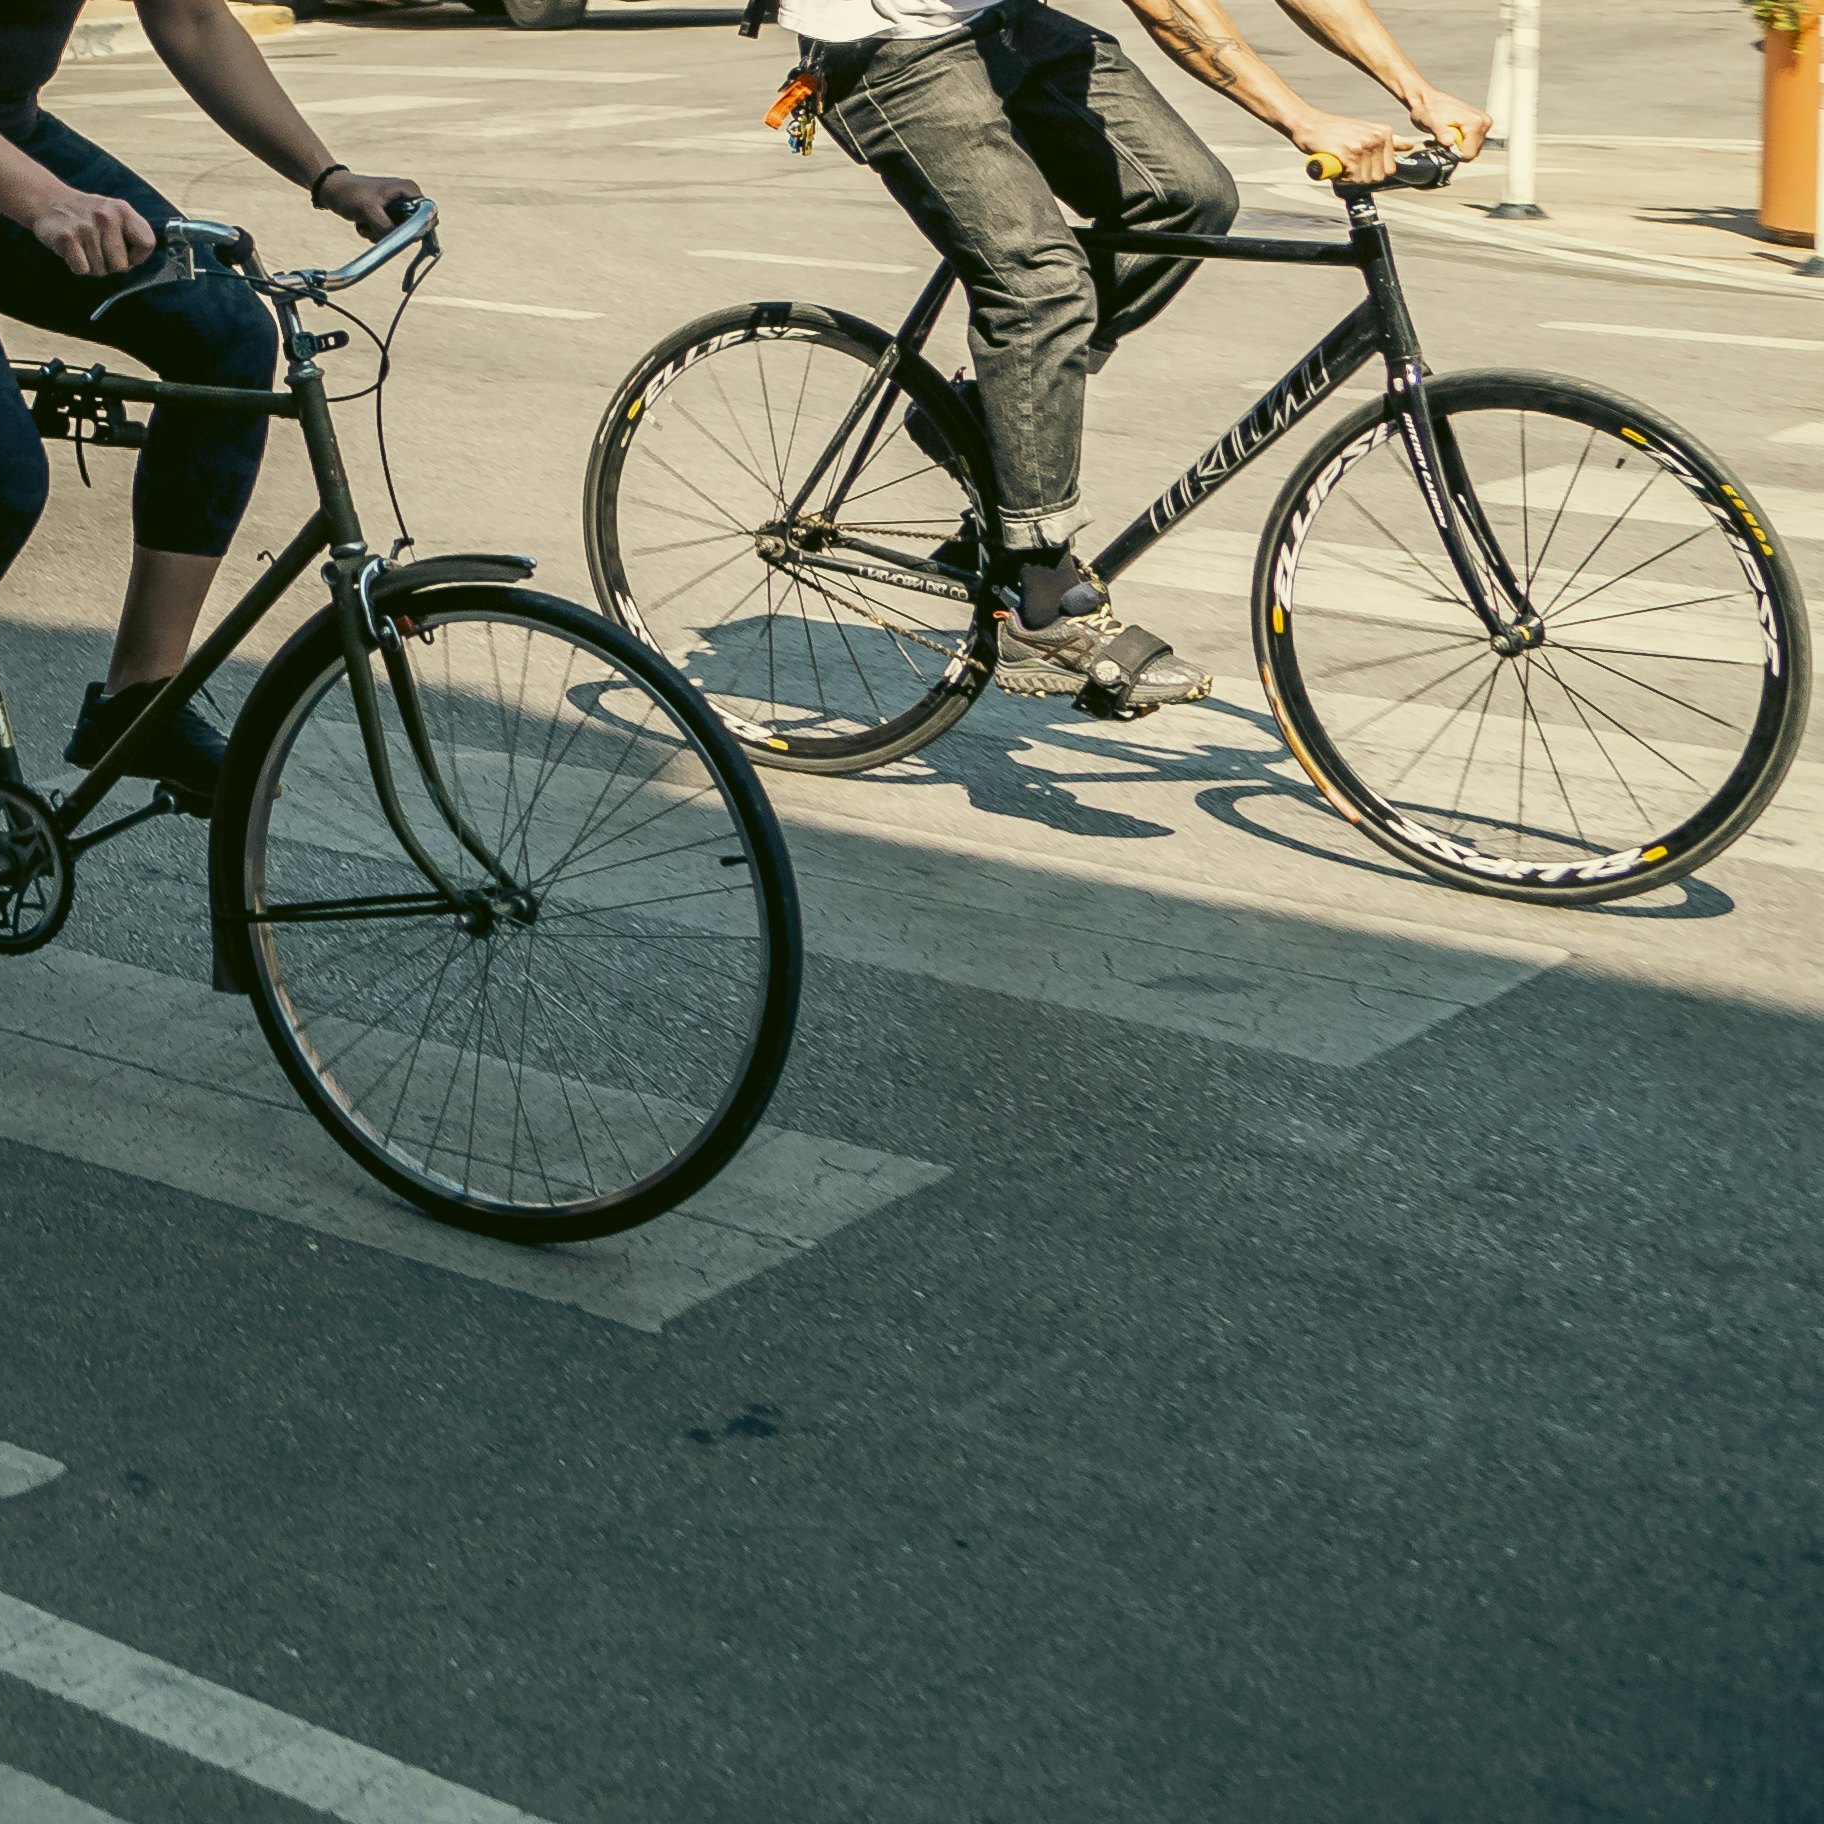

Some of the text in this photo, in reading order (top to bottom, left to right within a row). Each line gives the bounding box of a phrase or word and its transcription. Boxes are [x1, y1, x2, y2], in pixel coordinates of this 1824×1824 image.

[1401, 412, 1448, 529] RITCHEY CARBON
[1719, 484, 1775, 557] KENDA
[1384, 817, 1644, 882] ELLIPSE
